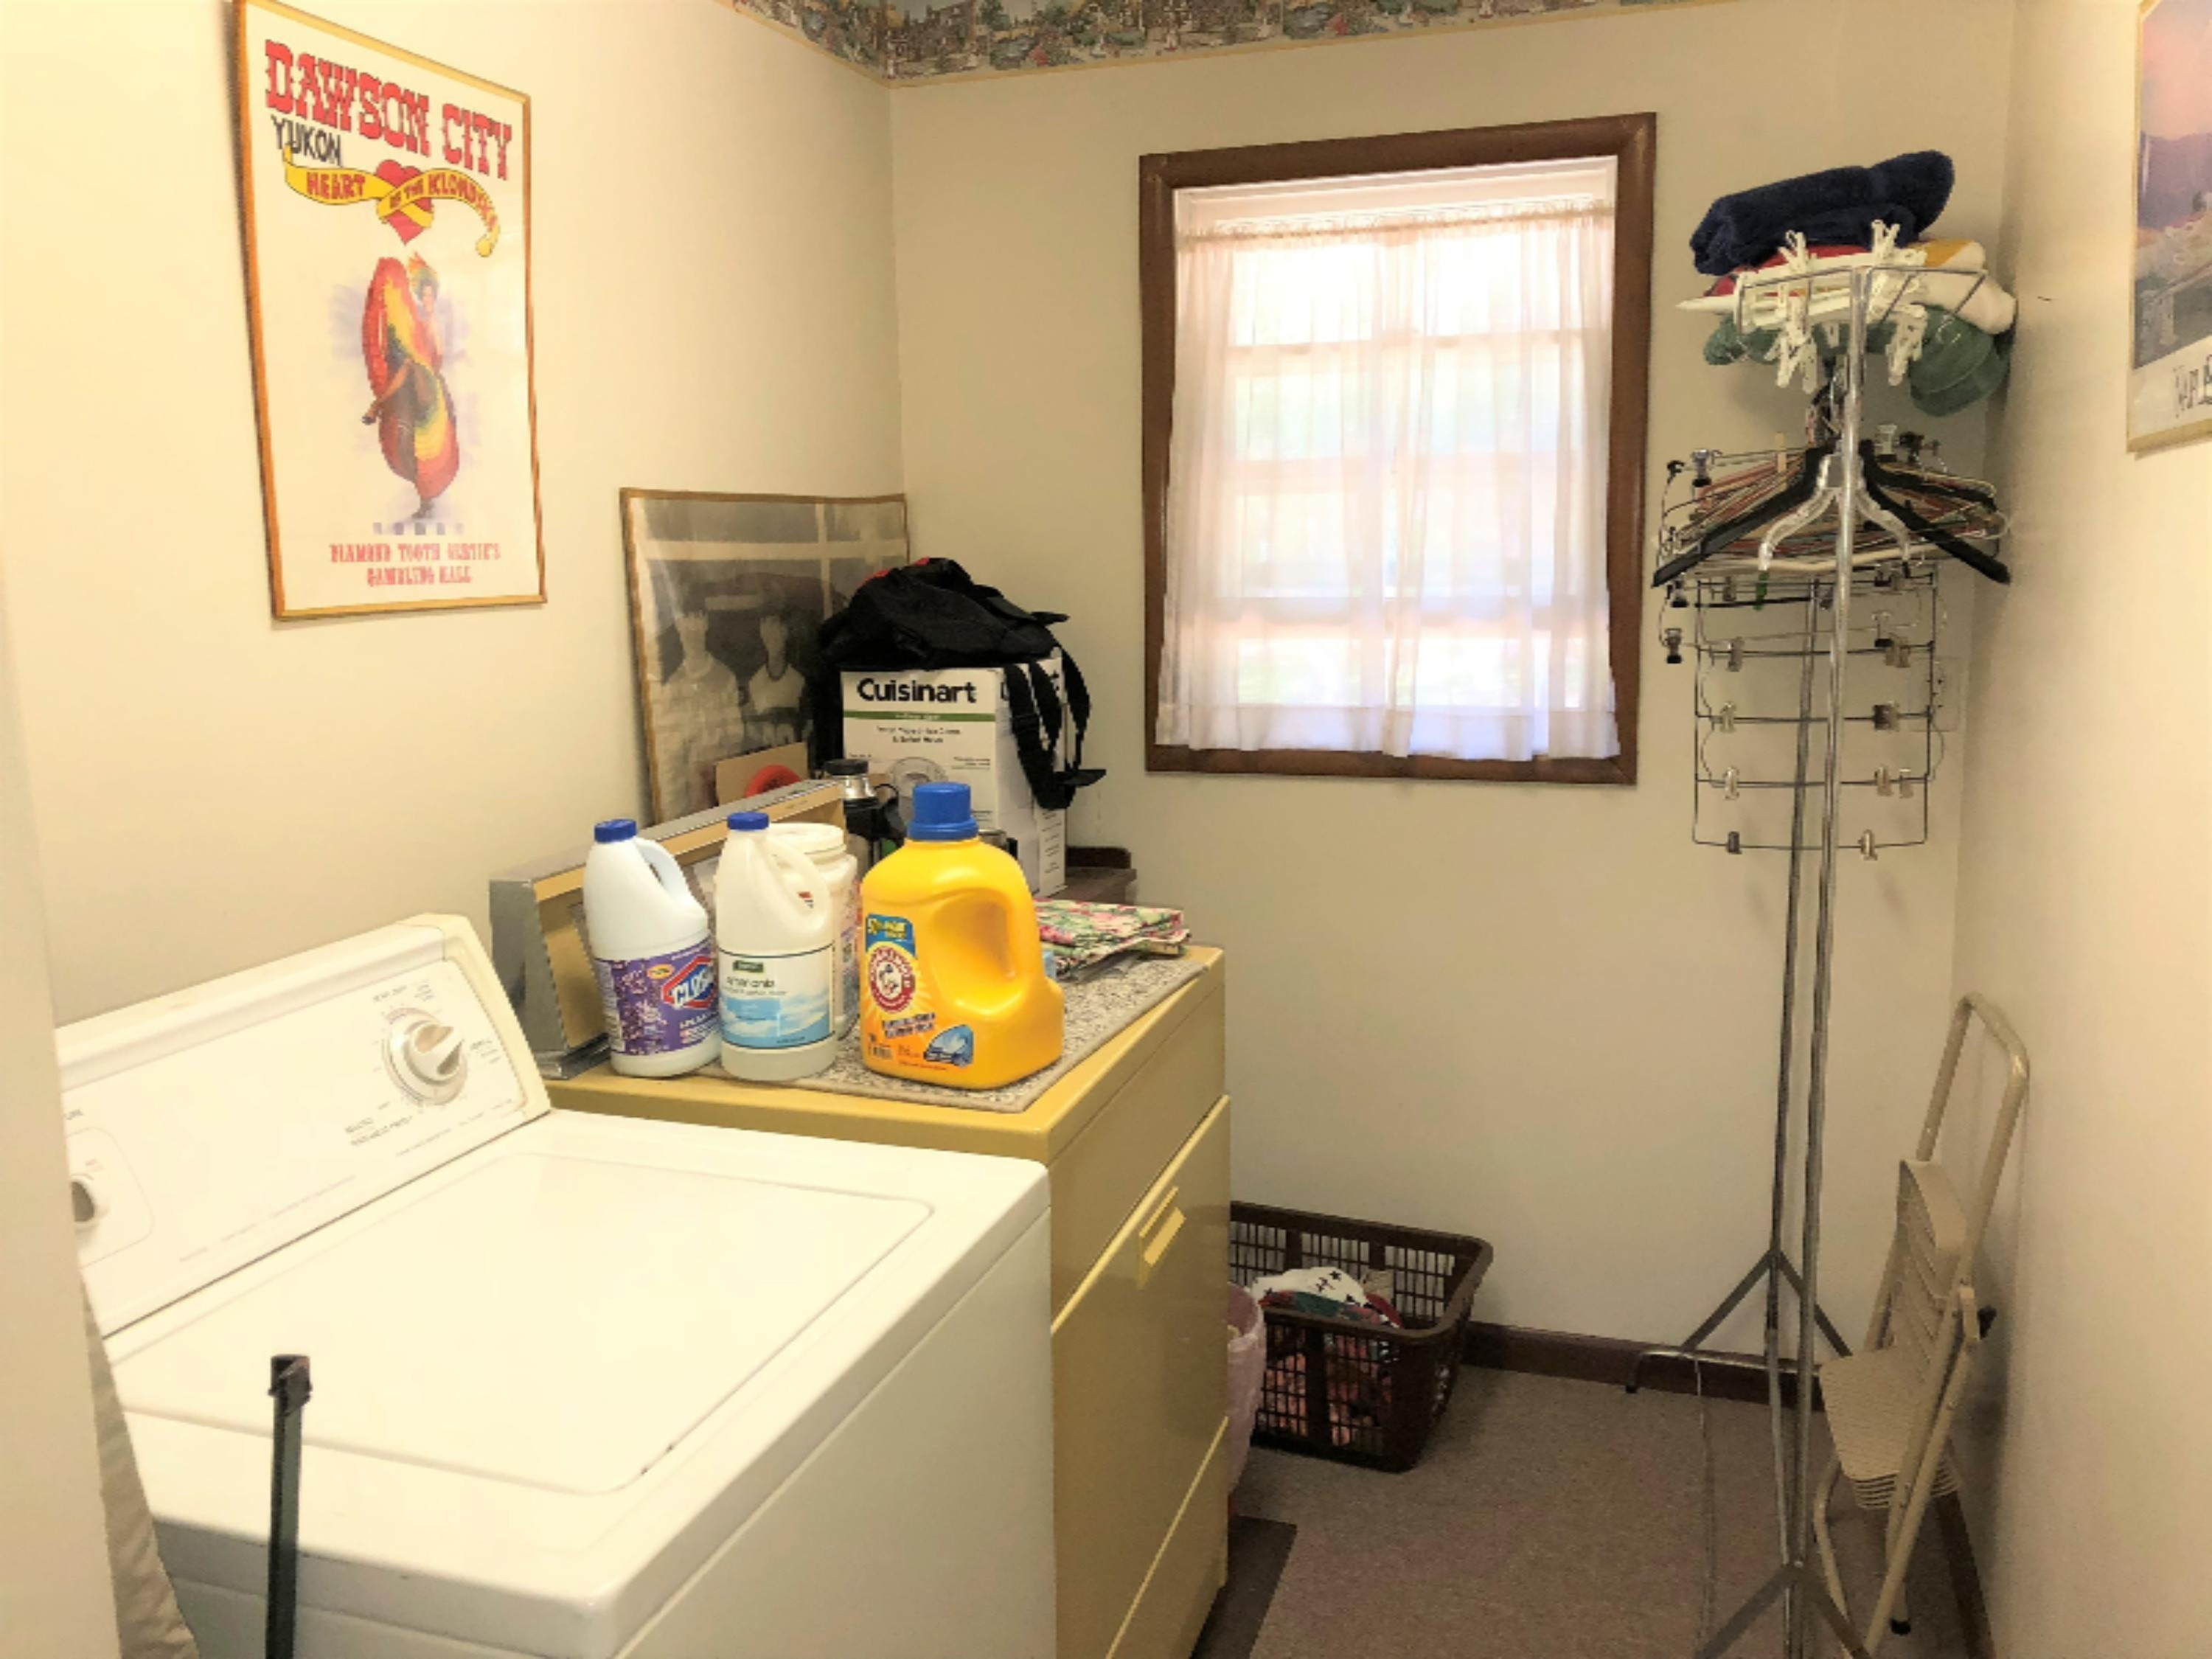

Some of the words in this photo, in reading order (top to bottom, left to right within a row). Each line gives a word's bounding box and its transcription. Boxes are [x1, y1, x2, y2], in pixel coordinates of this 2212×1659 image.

[265, 39, 430, 156] DAWSON
[442, 103, 512, 180] CITY
[271, 114, 342, 166] YUKON
[306, 171, 366, 199] HEART
[397, 543, 440, 561] TOOTH
[857, 678, 977, 703] Cuisinart
[671, 964, 714, 1009] CLOR
